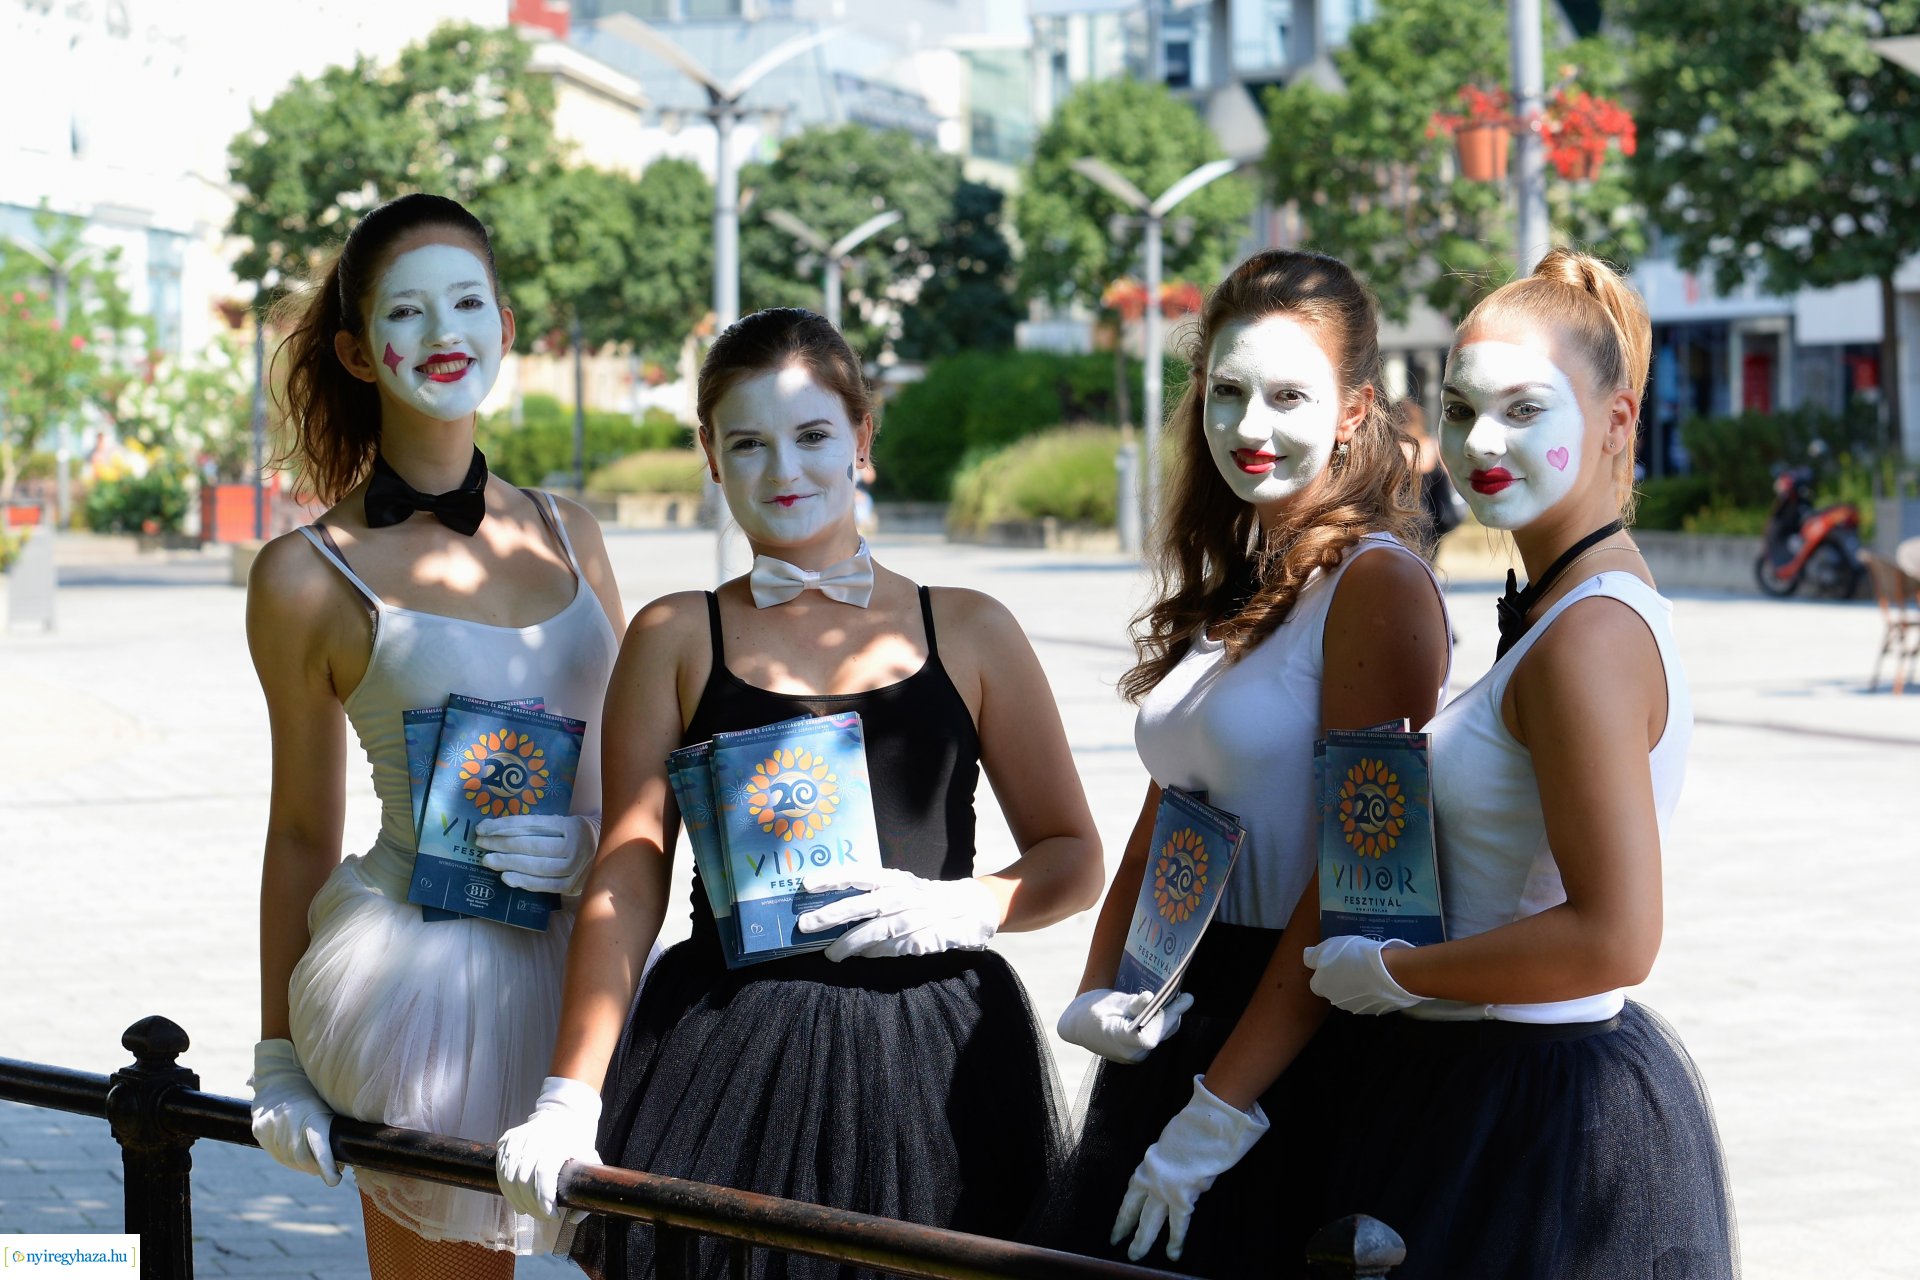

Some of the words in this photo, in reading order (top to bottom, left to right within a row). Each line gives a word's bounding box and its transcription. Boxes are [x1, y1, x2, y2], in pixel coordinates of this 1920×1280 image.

[481, 758, 527, 795] 20
[768, 780, 818, 813] 20
[1353, 792, 1388, 829] 20
[745, 837, 858, 878] VIDOR
[470, 885, 490, 898] BH
[1167, 856, 1195, 899] 20
[1331, 862, 1418, 895] VIDOR
[1344, 896, 1402, 907] FESZTIVÁL
[1137, 911, 1187, 966] VIDOR
[1137, 945, 1172, 975] FESZTIVÁL
